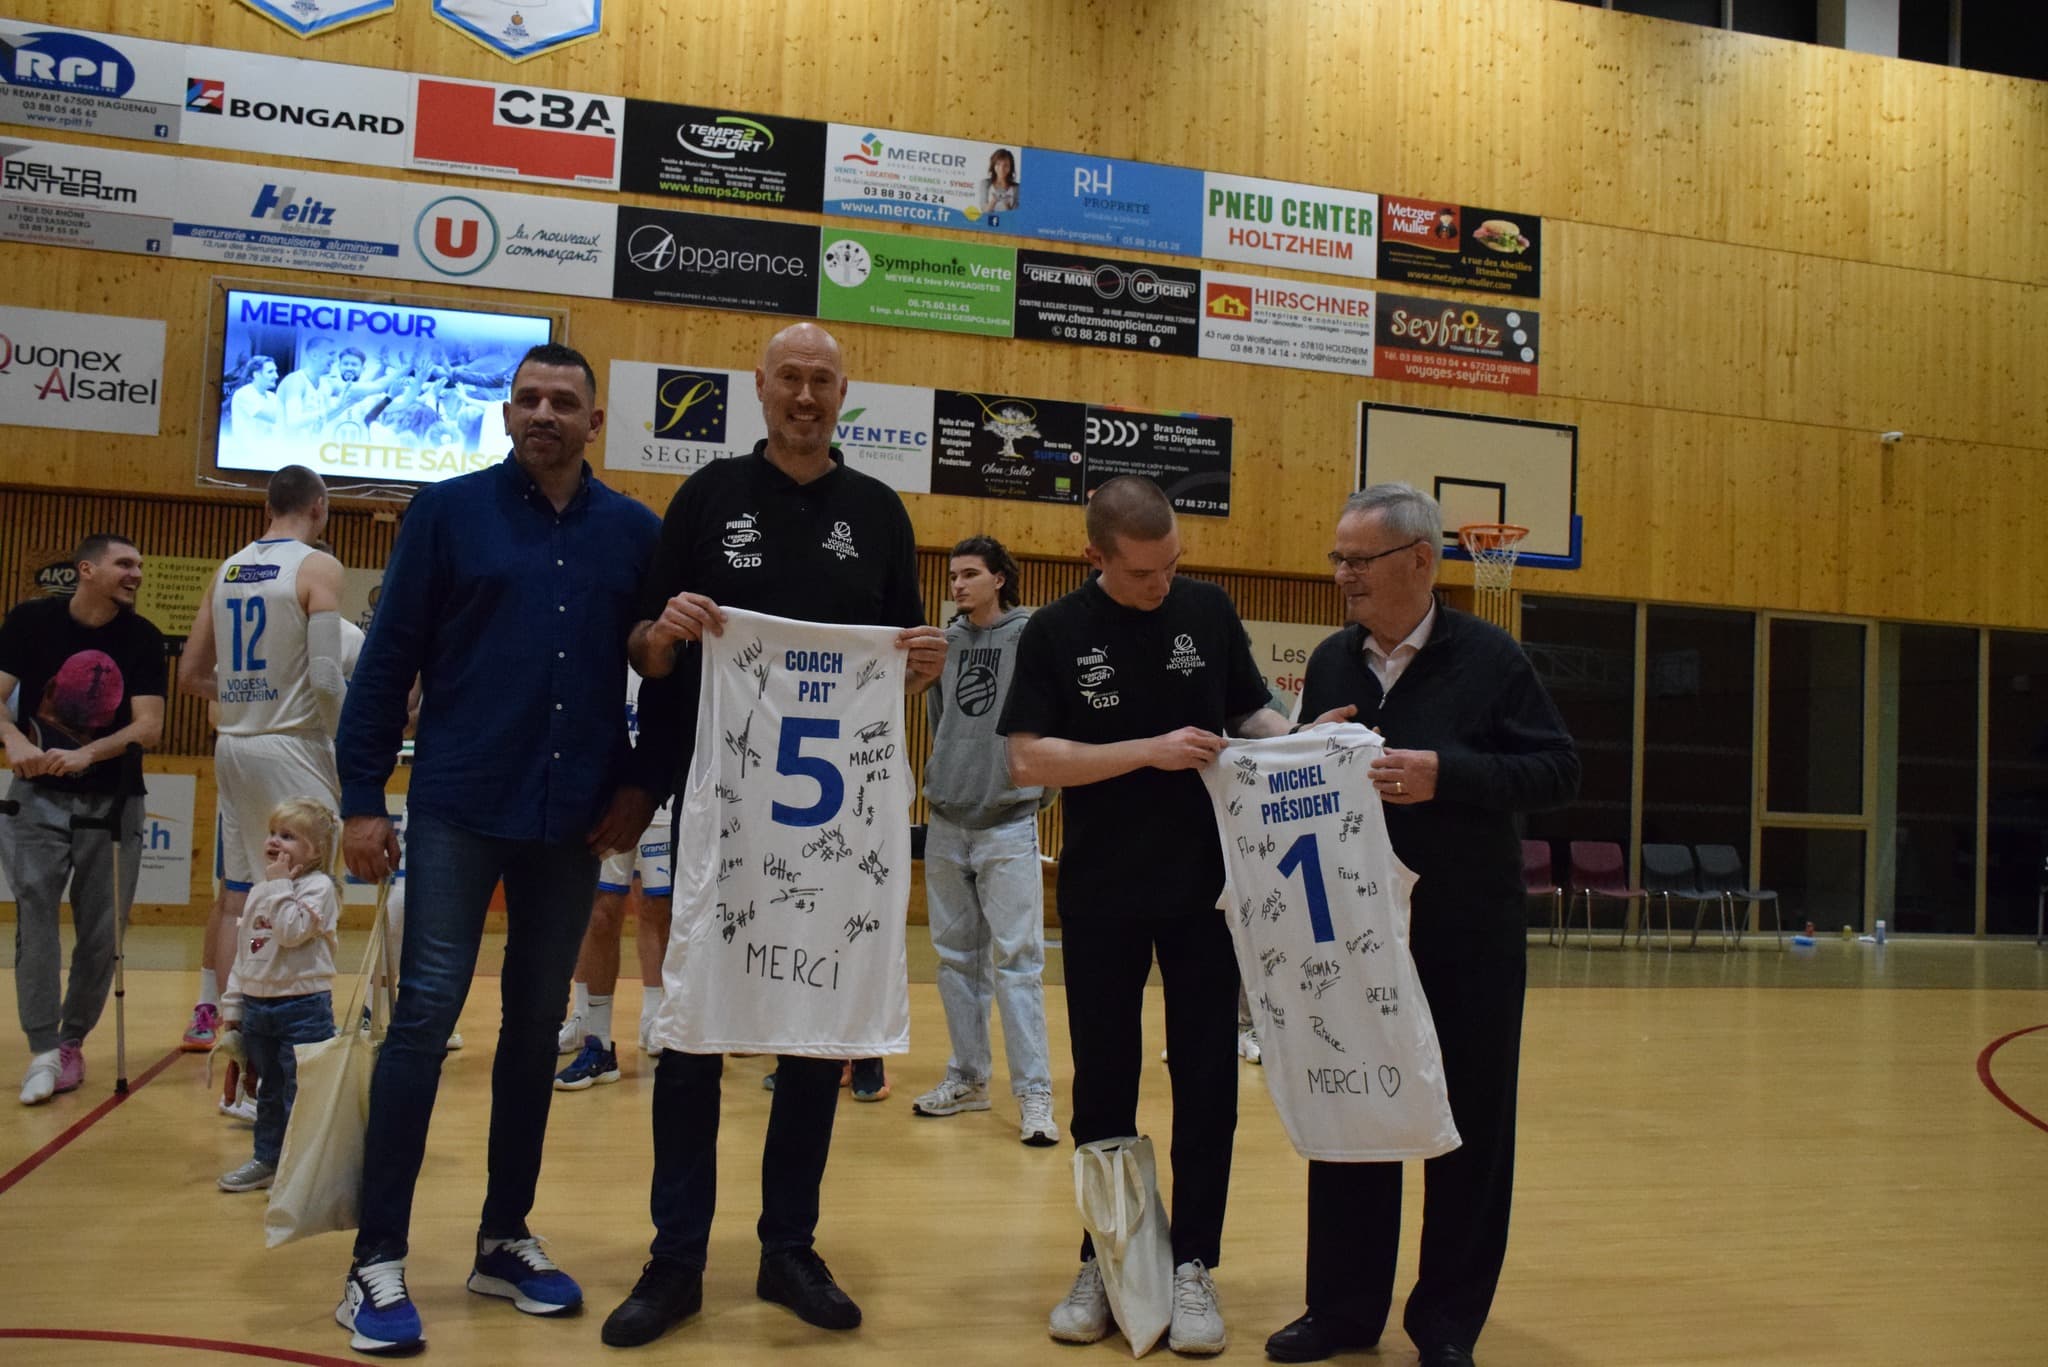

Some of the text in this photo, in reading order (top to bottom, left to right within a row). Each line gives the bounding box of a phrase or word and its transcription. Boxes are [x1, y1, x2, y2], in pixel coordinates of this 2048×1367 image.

[16, 50, 118, 88] RPI
[13, 89, 157, 114] REMPART 67500 HAGUENAU
[23, 101, 82, 116] 03 45
[499, 90, 615, 135] CBA
[230, 98, 404, 135] BONGARD
[701, 136, 763, 153] SPORT
[888, 147, 967, 168] MERCOR
[4, 160, 102, 184] DELTA
[835, 166, 857, 175] VENTE
[866, 170, 900, 180] LOCATION
[1074, 164, 1113, 197] RH
[4, 175, 137, 203] INTERIM
[659, 180, 785, 203] www.temps2sport.fr
[864, 186, 877, 196] 03
[881, 188, 894, 198] 88
[898, 190, 911, 200] 30
[915, 193, 928, 202] 24
[932, 194, 944, 204] 24
[251, 183, 336, 226] Heitz
[841, 200, 950, 222] www.mercor.fr
[1209, 188, 1373, 237] PNEU CENTER
[1388, 202, 1436, 224] Metzger
[36, 216, 91, 228] STRASBOURG
[1392, 219, 1430, 235] Muller
[190, 227, 384, 254] serrurerie menuiserie aluminium
[434, 217, 479, 258] U
[532, 229, 601, 247] nouveaux
[1229, 227, 1353, 260] HOLTZHEIM
[319, 251, 369, 262] HOLTZHEIM
[506, 243, 602, 265] commerçants
[1468, 258, 1482, 266] rue
[1484, 258, 1498, 268] des
[1499, 260, 1532, 272] Abeilles
[873, 253, 1012, 281] Symphonie Verte
[944, 279, 1000, 293] PAYSAGISTES
[1030, 269, 1189, 298] CHEZ MON OPTICIEN
[1407, 270, 1512, 290] www.metzger-muller.com
[1019, 299, 1042, 308] CENTRE
[1042, 301, 1068, 311] LECLERC
[1254, 288, 1369, 318] HIRSCHNER
[240, 299, 436, 340] MERCI POUR
[1038, 310, 1177, 335] www.chezmonopticien.com
[1254, 310, 1369, 329] entreprise de construction
[1391, 309, 1499, 348] Seyfritz
[1064, 326, 1137, 345] 03 88 26 81 58
[1205, 330, 1368, 355] 43 rue de Wolfisheim 67810 HOLTZHEIM
[1230, 344, 1368, 366] 03 14 14 info@hirschner.fr
[1400, 353, 1410, 362] 03
[1470, 361, 1495, 372] 67210
[1497, 364, 1531, 376] OBERNAI
[1405, 364, 1510, 385] voyages-seyfritz.fr
[34, 367, 157, 405] Alsatel
[1154, 423, 1198, 436] Bras Droit
[1154, 433, 1216, 447] des Dirigeants
[940, 438, 972, 448] Biologique
[319, 441, 414, 471] CETTE
[939, 457, 972, 467] Producteur
[1033, 450, 1068, 462] SUPER
[1105, 459, 1129, 467] sommes
[1164, 464, 1189, 472] direction
[726, 520, 752, 529] PUMA
[732, 536, 757, 544] SPORT
[822, 542, 859, 559] HOLTZHEIM
[828, 537, 855, 551] VOGESIA
[733, 557, 762, 568] G2D
[156, 582, 202, 592] Isolation
[157, 573, 201, 582] Peinture
[226, 596, 267, 672] 12
[785, 650, 843, 674] COACH
[957, 648, 1002, 678] PUMA
[1077, 654, 1104, 666] PUMA
[1170, 655, 1200, 663] VOGESIA
[1272, 644, 1306, 664] Les
[1166, 661, 1205, 670] HOLTZHEIM
[1087, 672, 1111, 683] SPORT
[798, 681, 836, 703] PAT'
[1093, 695, 1120, 709] G2D
[850, 744, 895, 767] MACKO
[772, 716, 844, 828] 5
[1268, 765, 1326, 795] MICHEL
[1261, 791, 1340, 825] PRÉSIDENT
[642, 844, 667, 853] Grand
[1259, 834, 1275, 859] #6
[764, 853, 802, 883] Potter
[1277, 833, 1336, 943] 1
[1357, 882, 1378, 897] #13
[1301, 956, 1340, 979] THOMAS
[1366, 987, 1398, 1003] BELIN
